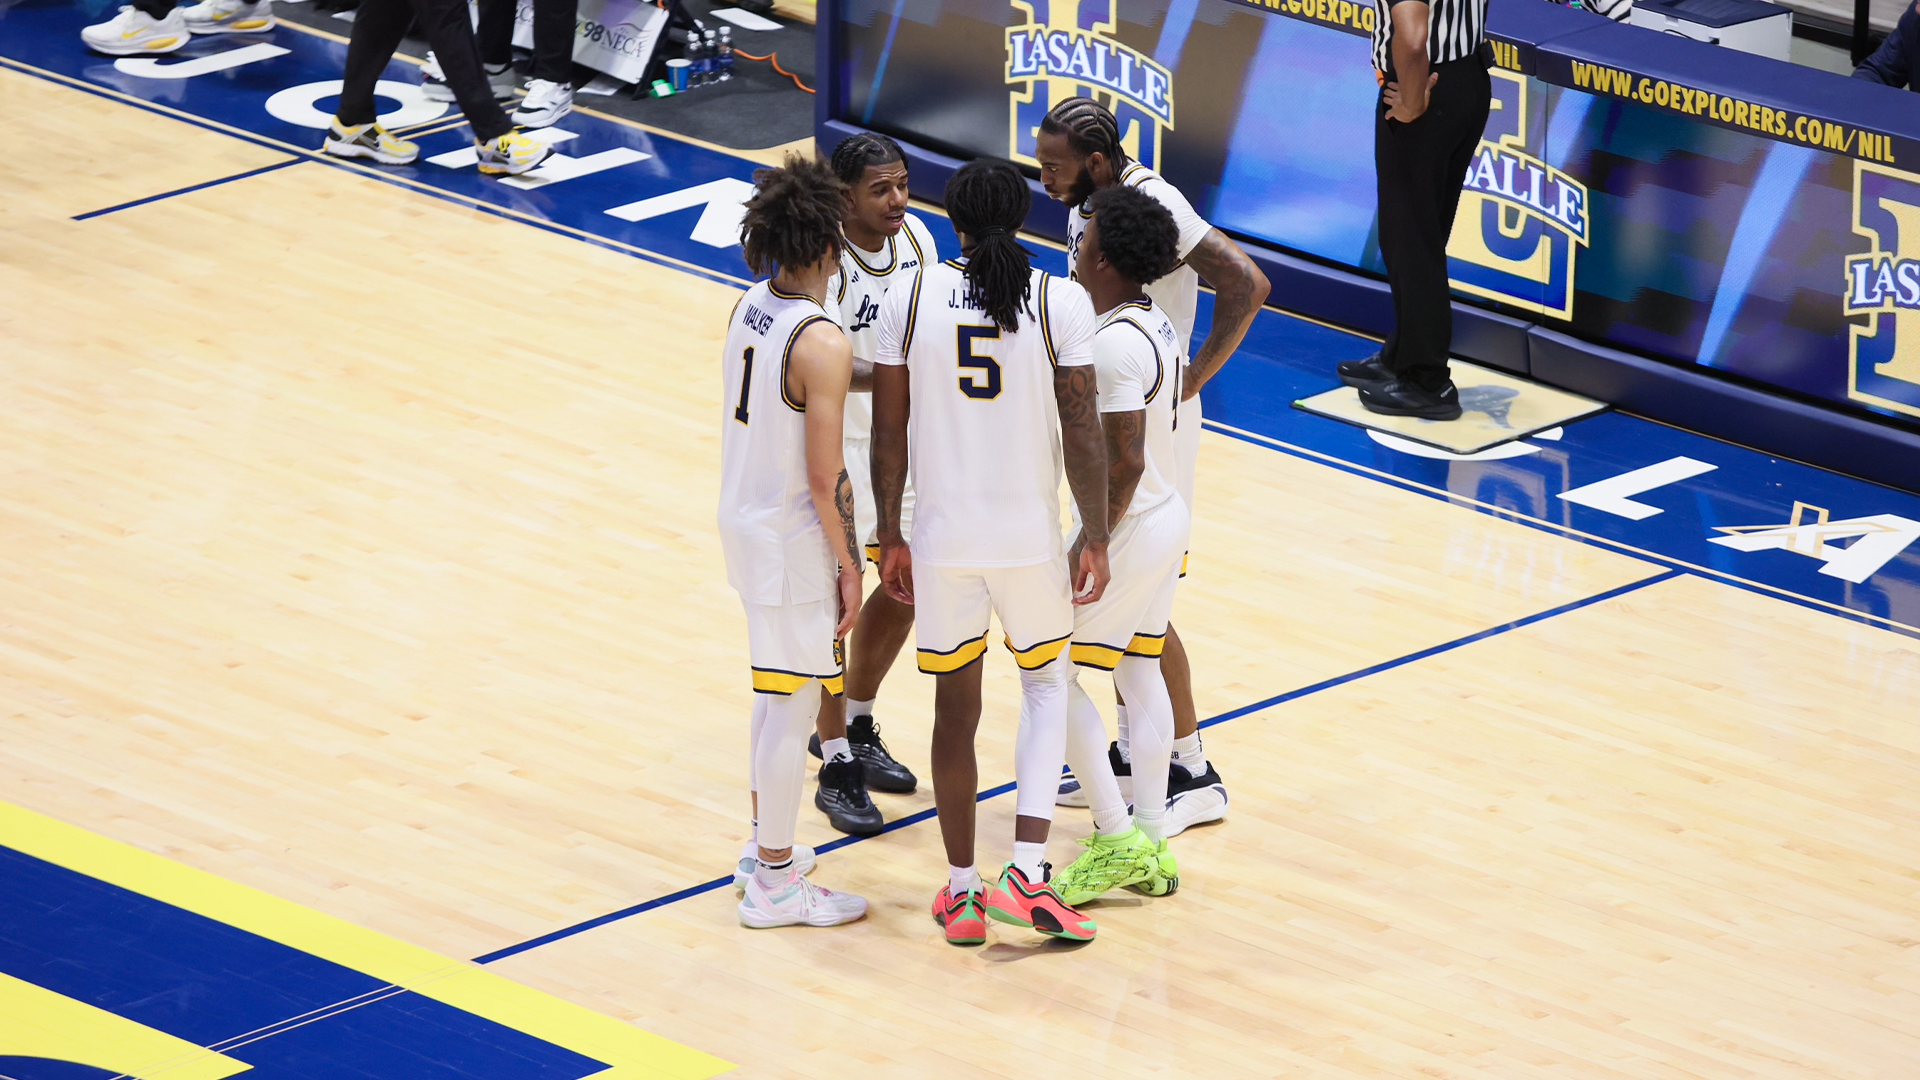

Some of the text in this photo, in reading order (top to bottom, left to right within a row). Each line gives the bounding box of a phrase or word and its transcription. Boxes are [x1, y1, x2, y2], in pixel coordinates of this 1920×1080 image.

[602, 30, 642, 57] NECA
[1571, 60, 1895, 163] WWW.GOEXPLORERS.COM/NIL
[743, 303, 774, 338] WALKER
[734, 345, 755, 427] 1
[956, 322, 1003, 401] 5
